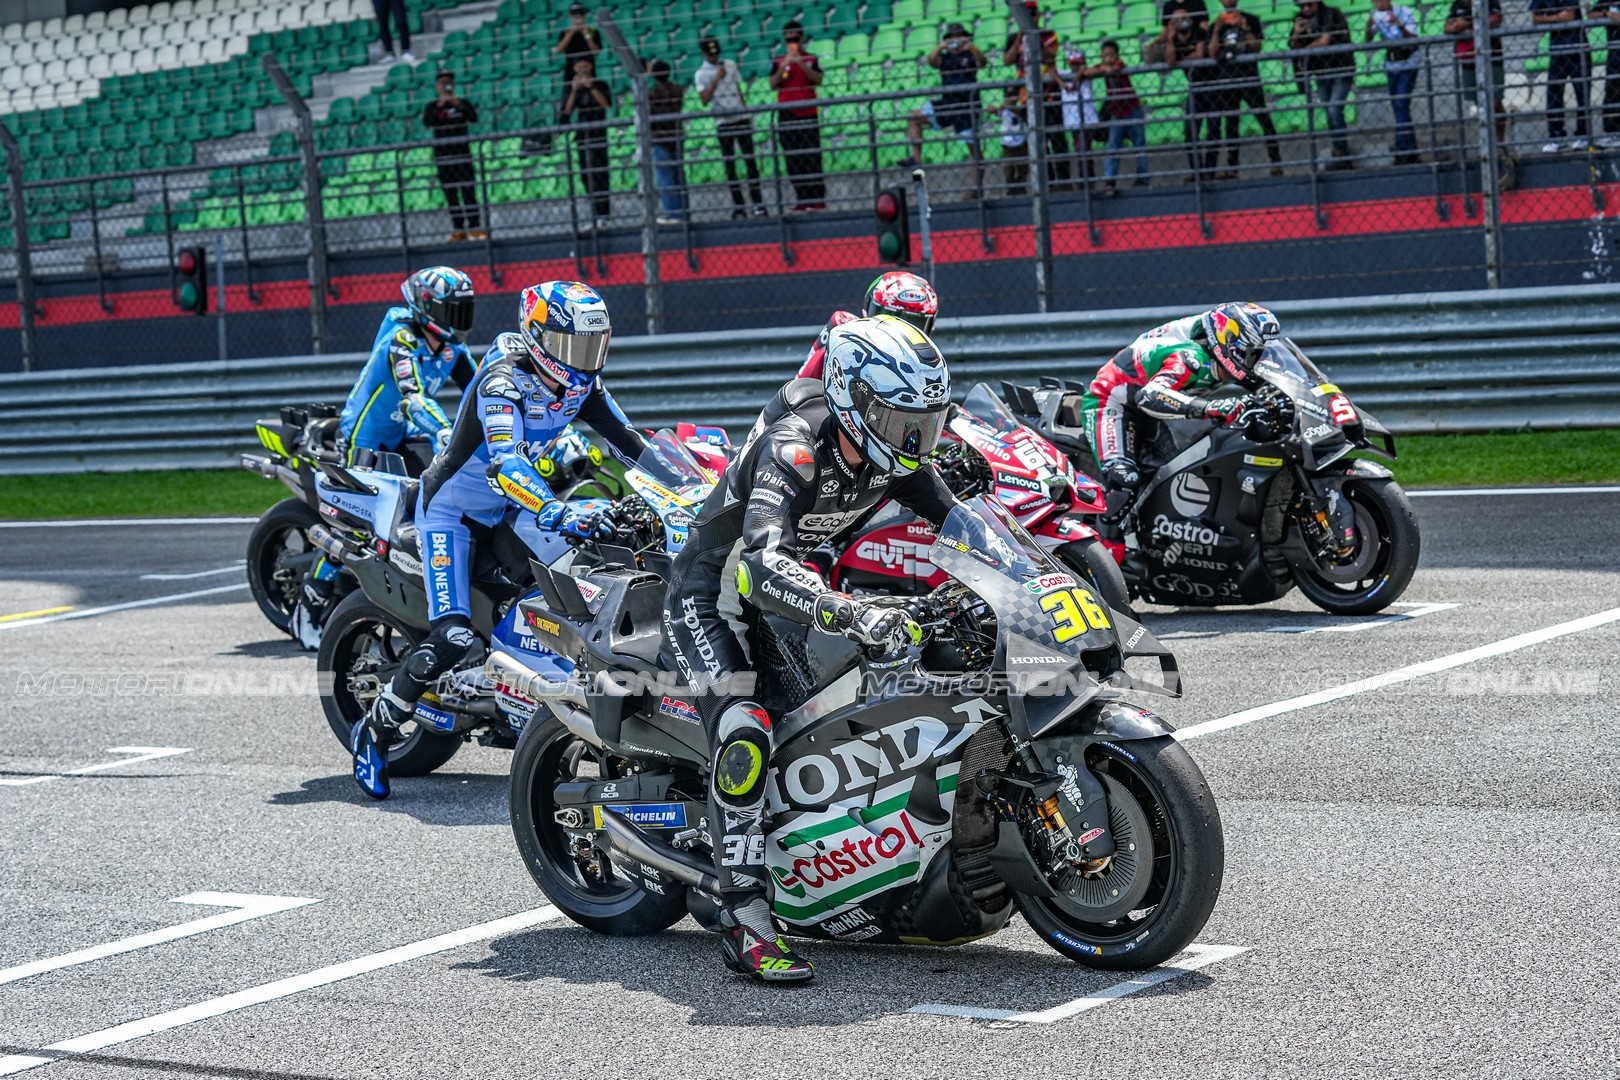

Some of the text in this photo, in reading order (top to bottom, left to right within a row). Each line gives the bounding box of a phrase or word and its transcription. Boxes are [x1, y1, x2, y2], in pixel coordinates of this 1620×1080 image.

[532, 345, 570, 380] Red Bull
[1213, 344, 1246, 381] Red Bull
[1106, 416, 1117, 455] Castrol
[832, 448, 855, 480] HONDA
[998, 472, 1041, 491] Lenovo
[505, 481, 540, 509] Antangin
[855, 540, 905, 565] GIVI
[431, 532, 452, 613] BK8 NEWS
[1039, 573, 1077, 590] Castrol
[761, 579, 782, 600] One
[1040, 588, 1112, 644] 36
[681, 596, 723, 686] HONDA
[1125, 625, 1148, 650] HONDA
[663, 609, 702, 694] DAINESE
[1009, 654, 1070, 666] HONDA
[415, 706, 448, 725] CHELIN
[659, 696, 702, 722] HRC
[629, 744, 654, 755] Honda
[721, 834, 766, 867] 36
[792, 810, 925, 889] Castrol
[639, 863, 660, 878] NGK
[643, 878, 665, 894] RK
[820, 915, 849, 937] Satu
[1055, 932, 1092, 953] MICHELIN
[758, 956, 796, 972] 36
